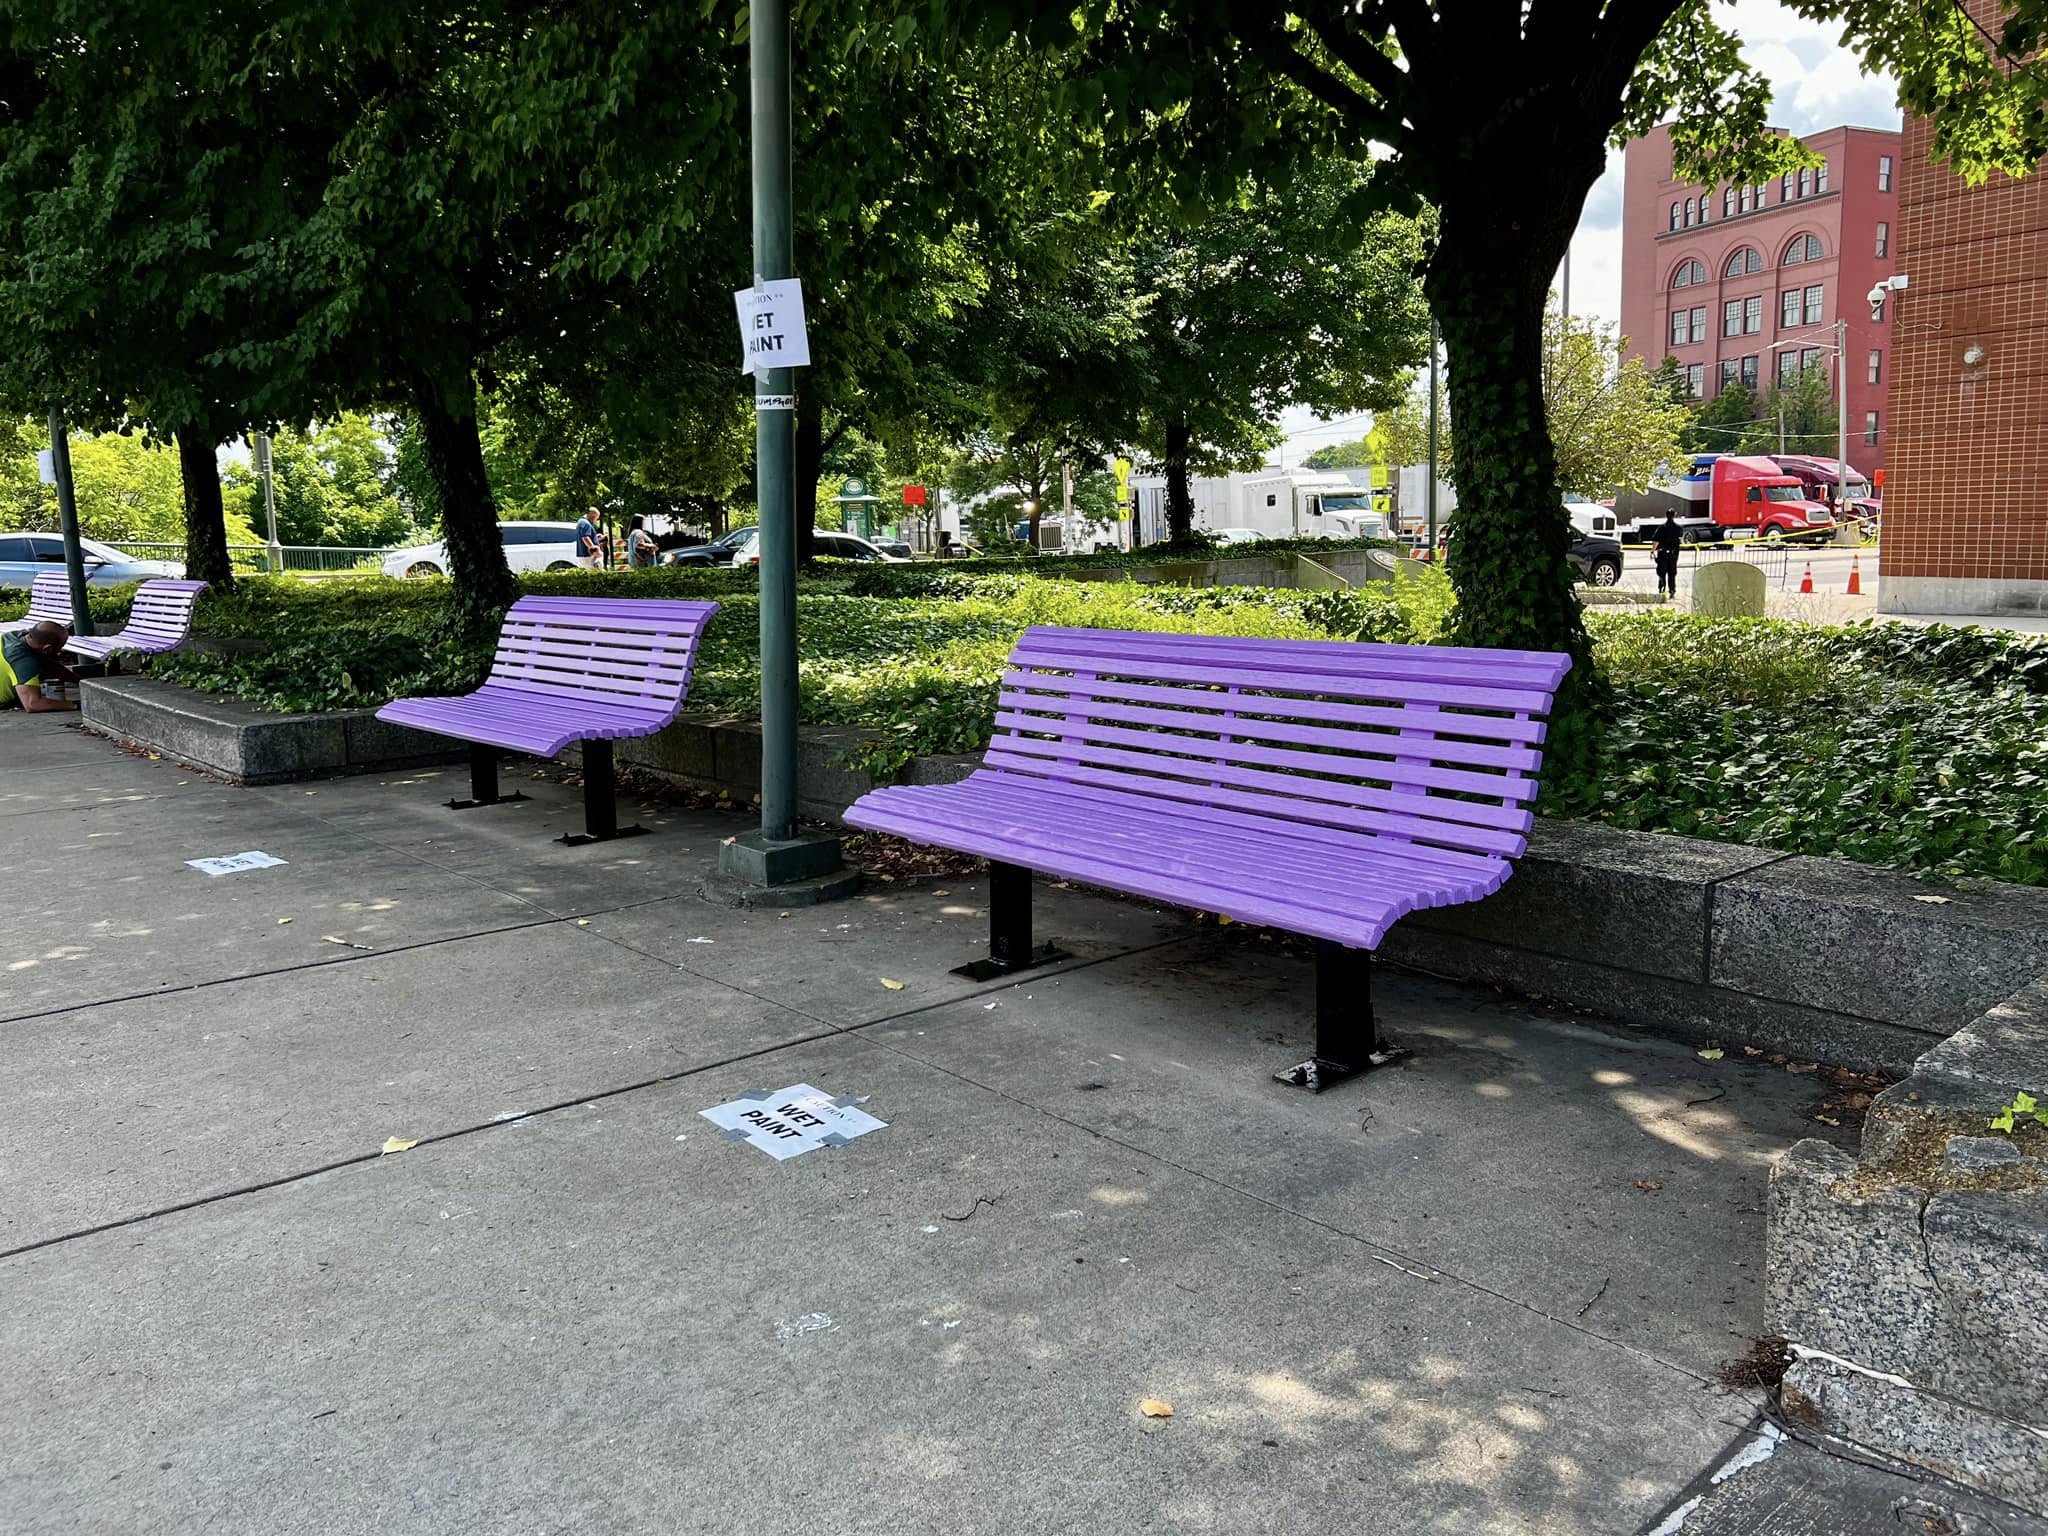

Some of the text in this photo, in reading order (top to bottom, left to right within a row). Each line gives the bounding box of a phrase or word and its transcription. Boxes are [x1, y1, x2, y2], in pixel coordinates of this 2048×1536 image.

[752, 312, 774, 331] ET
[750, 334, 784, 355] AINT
[740, 1110, 803, 1140] PAINT
[776, 1103, 826, 1128] WET
